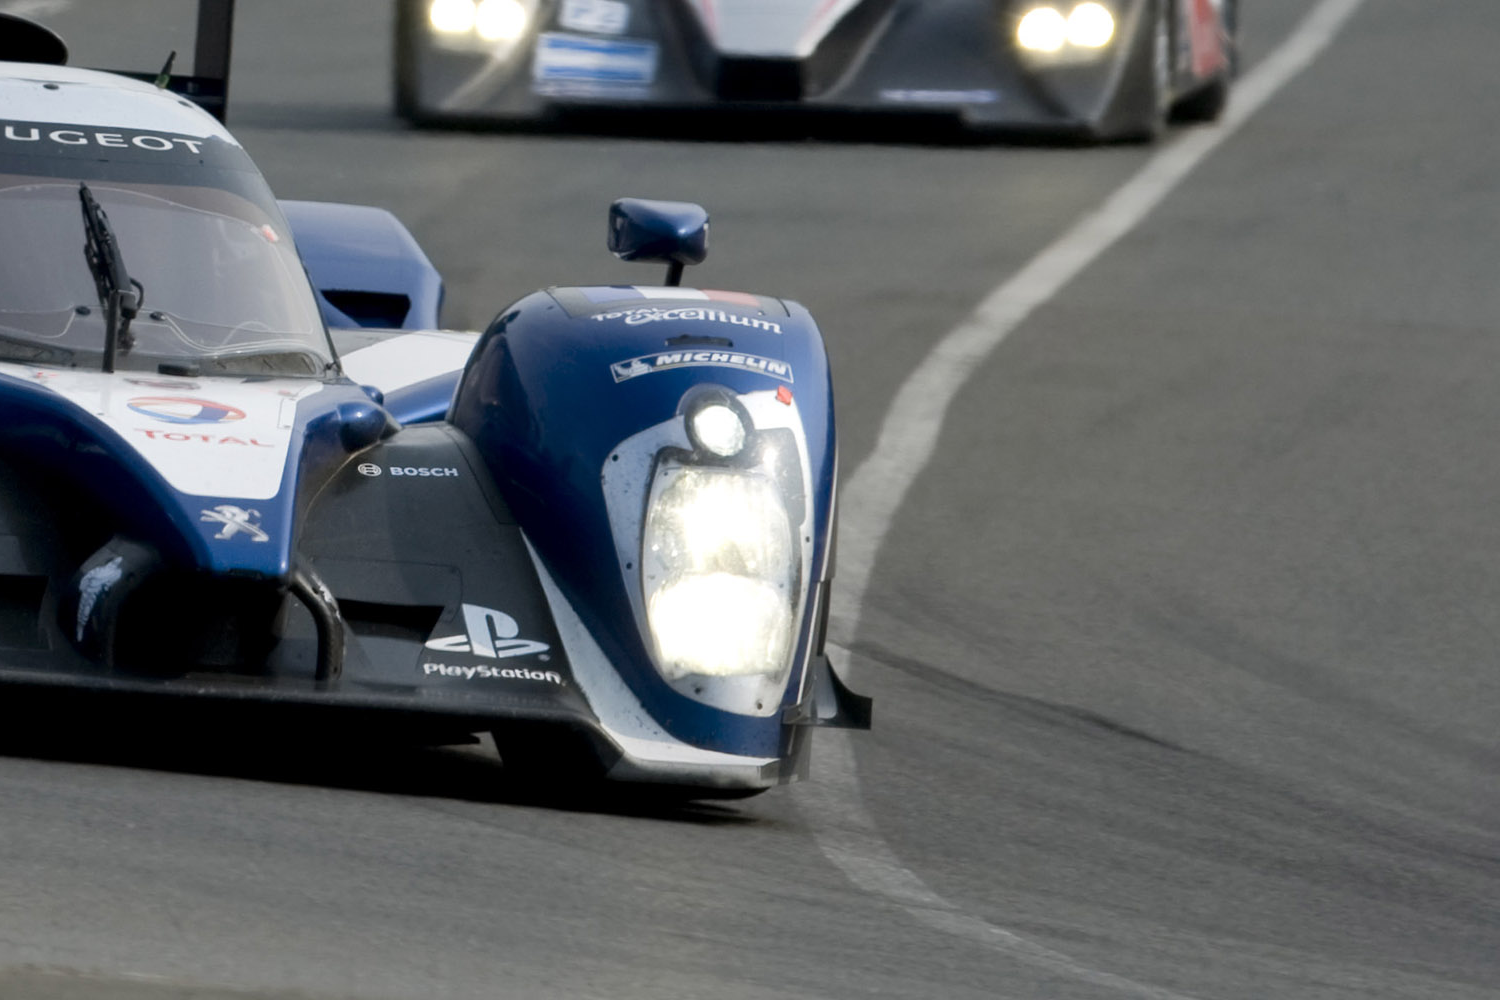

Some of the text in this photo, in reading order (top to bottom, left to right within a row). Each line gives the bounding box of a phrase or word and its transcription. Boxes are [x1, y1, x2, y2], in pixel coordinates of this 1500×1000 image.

[624, 308, 783, 335] excellium
[656, 352, 787, 376] MICHELIN
[134, 428, 275, 448] TOTAL
[389, 466, 459, 477] BOSCH
[423, 662, 562, 685] PlayStation
